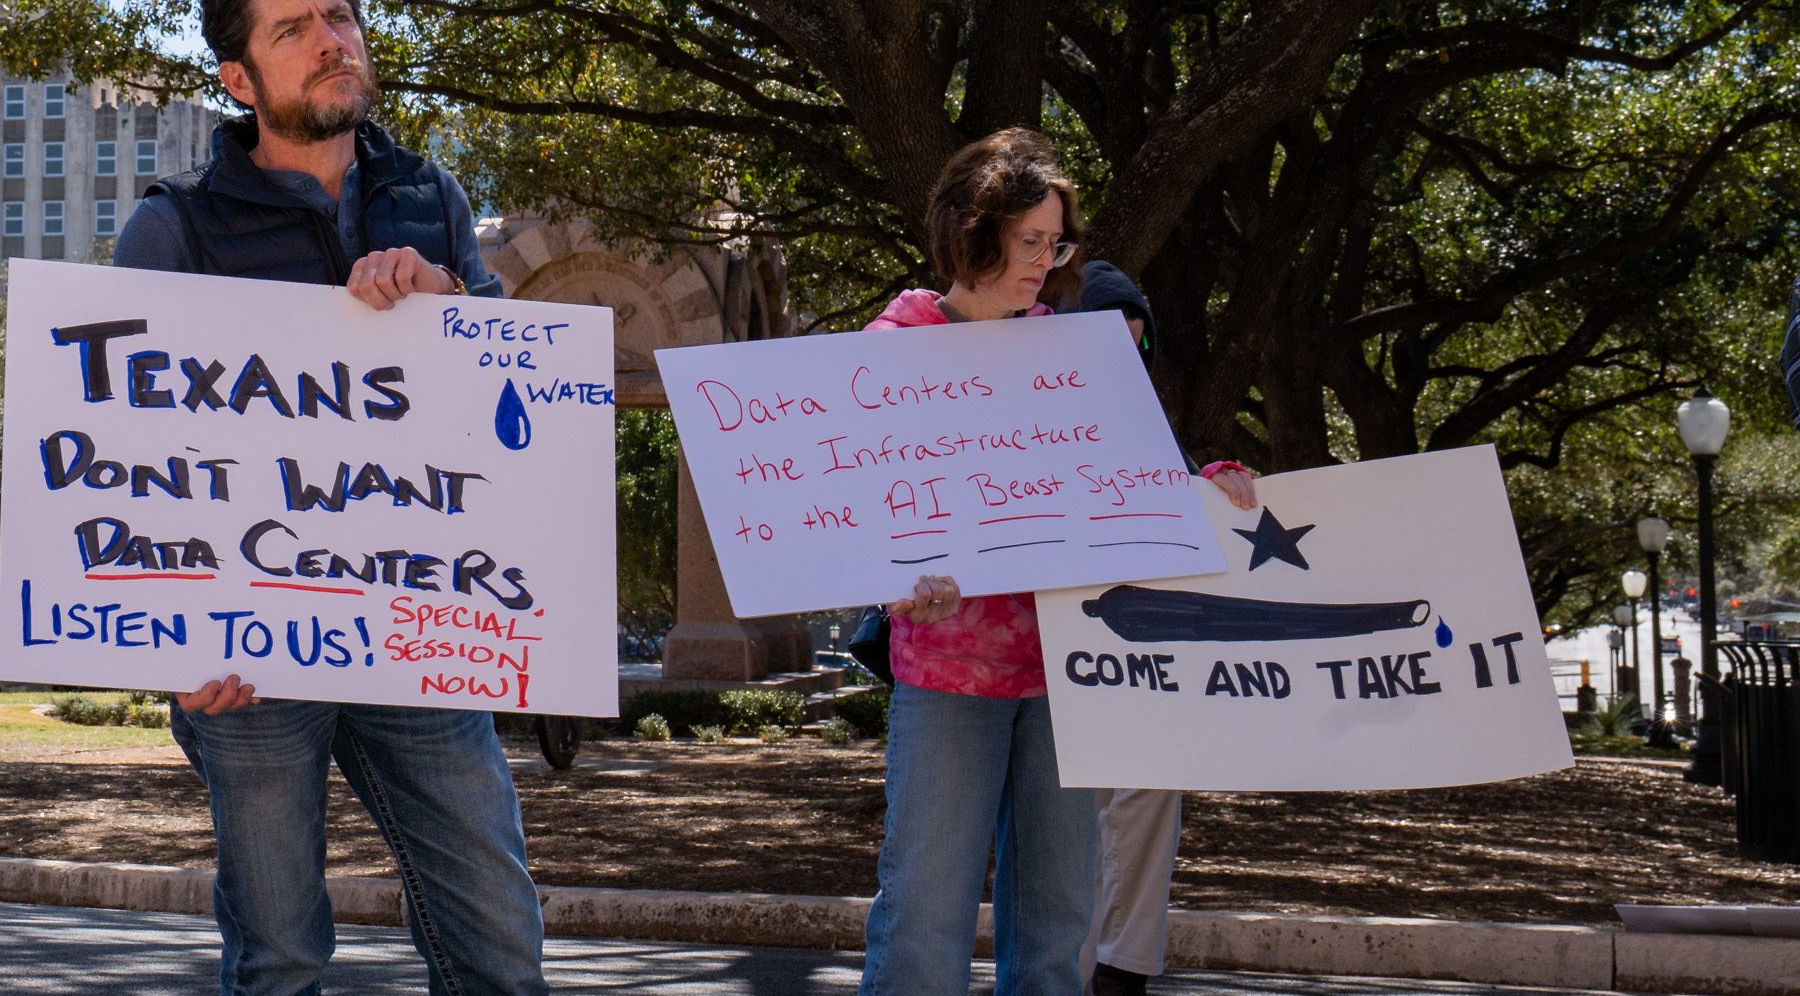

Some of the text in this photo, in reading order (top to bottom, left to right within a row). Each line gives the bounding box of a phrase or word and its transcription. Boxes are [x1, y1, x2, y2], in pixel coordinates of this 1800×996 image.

[442, 307, 570, 345] PROTECT
[50, 319, 411, 421] TEXANS
[478, 351, 538, 370] OUR
[526, 378, 615, 406] WATER
[697, 367, 1086, 431] Data Centers are
[735, 421, 1103, 485] the Infrastructure
[276, 457, 492, 515] WANT
[735, 466, 1191, 543] to the AI Beast System
[74, 517, 534, 610] DATA CENTERS
[21, 579, 188, 649] LISTEN
[390, 596, 543, 641] SPECIAL
[384, 634, 529, 672] SESSION
[1066, 632, 1524, 700] COME AND TAKE IT
[421, 673, 530, 708] NOW!
